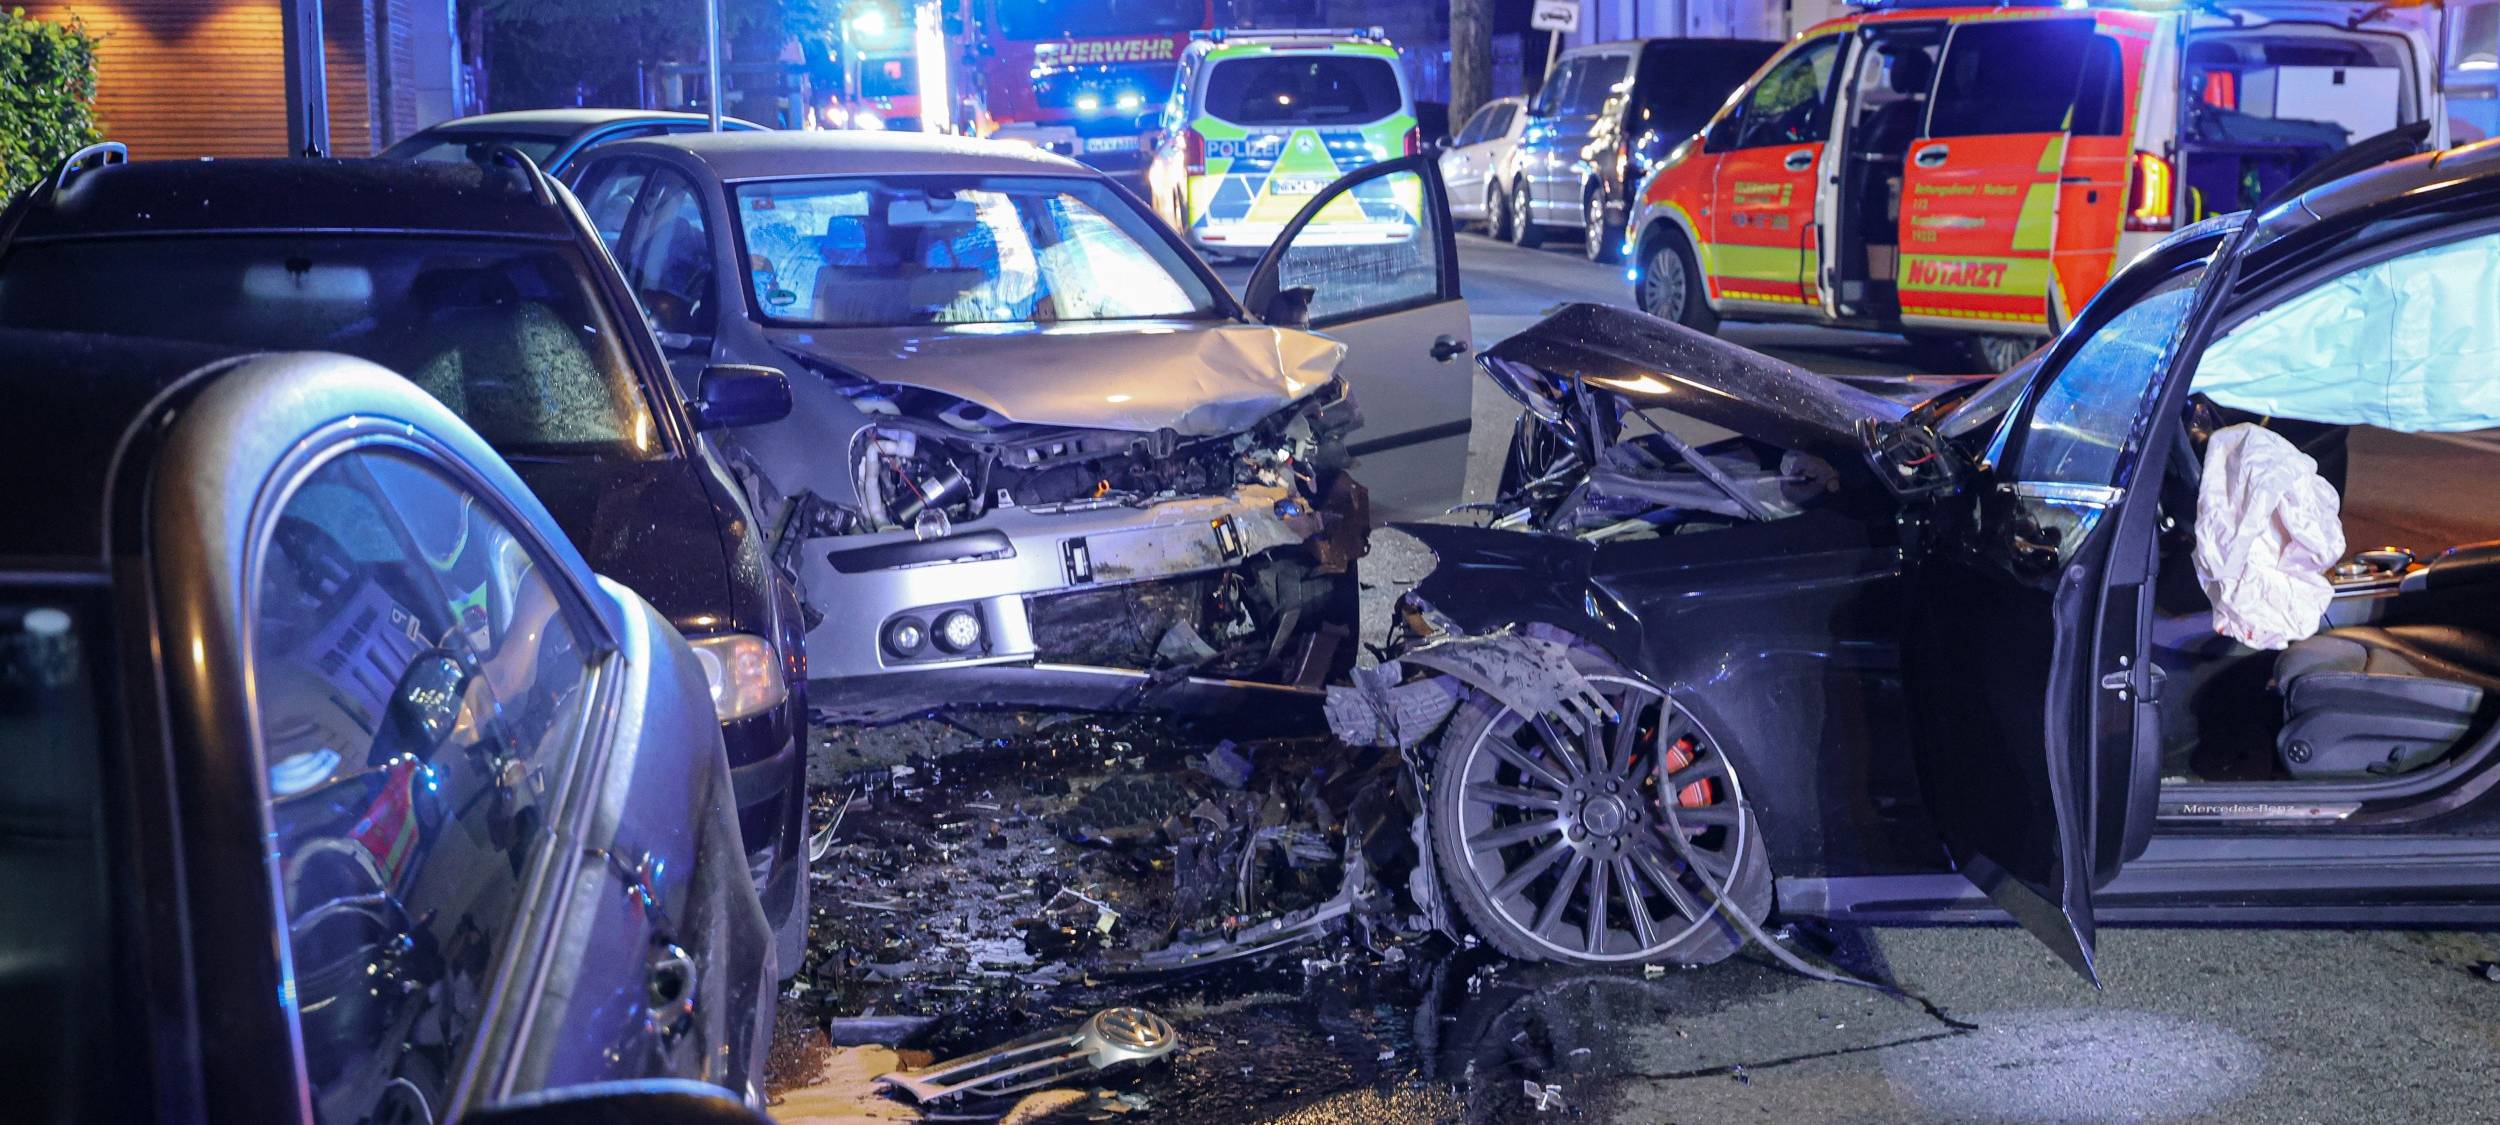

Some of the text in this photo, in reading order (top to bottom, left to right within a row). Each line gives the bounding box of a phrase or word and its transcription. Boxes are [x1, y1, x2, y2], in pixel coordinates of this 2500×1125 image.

[1034, 39, 1174, 66] FEUERWEHR
[1207, 142, 1280, 158] POLIZEI
[1907, 259, 2008, 288] NOTARZT
[2182, 804, 2296, 815] Mercedes-Benz
